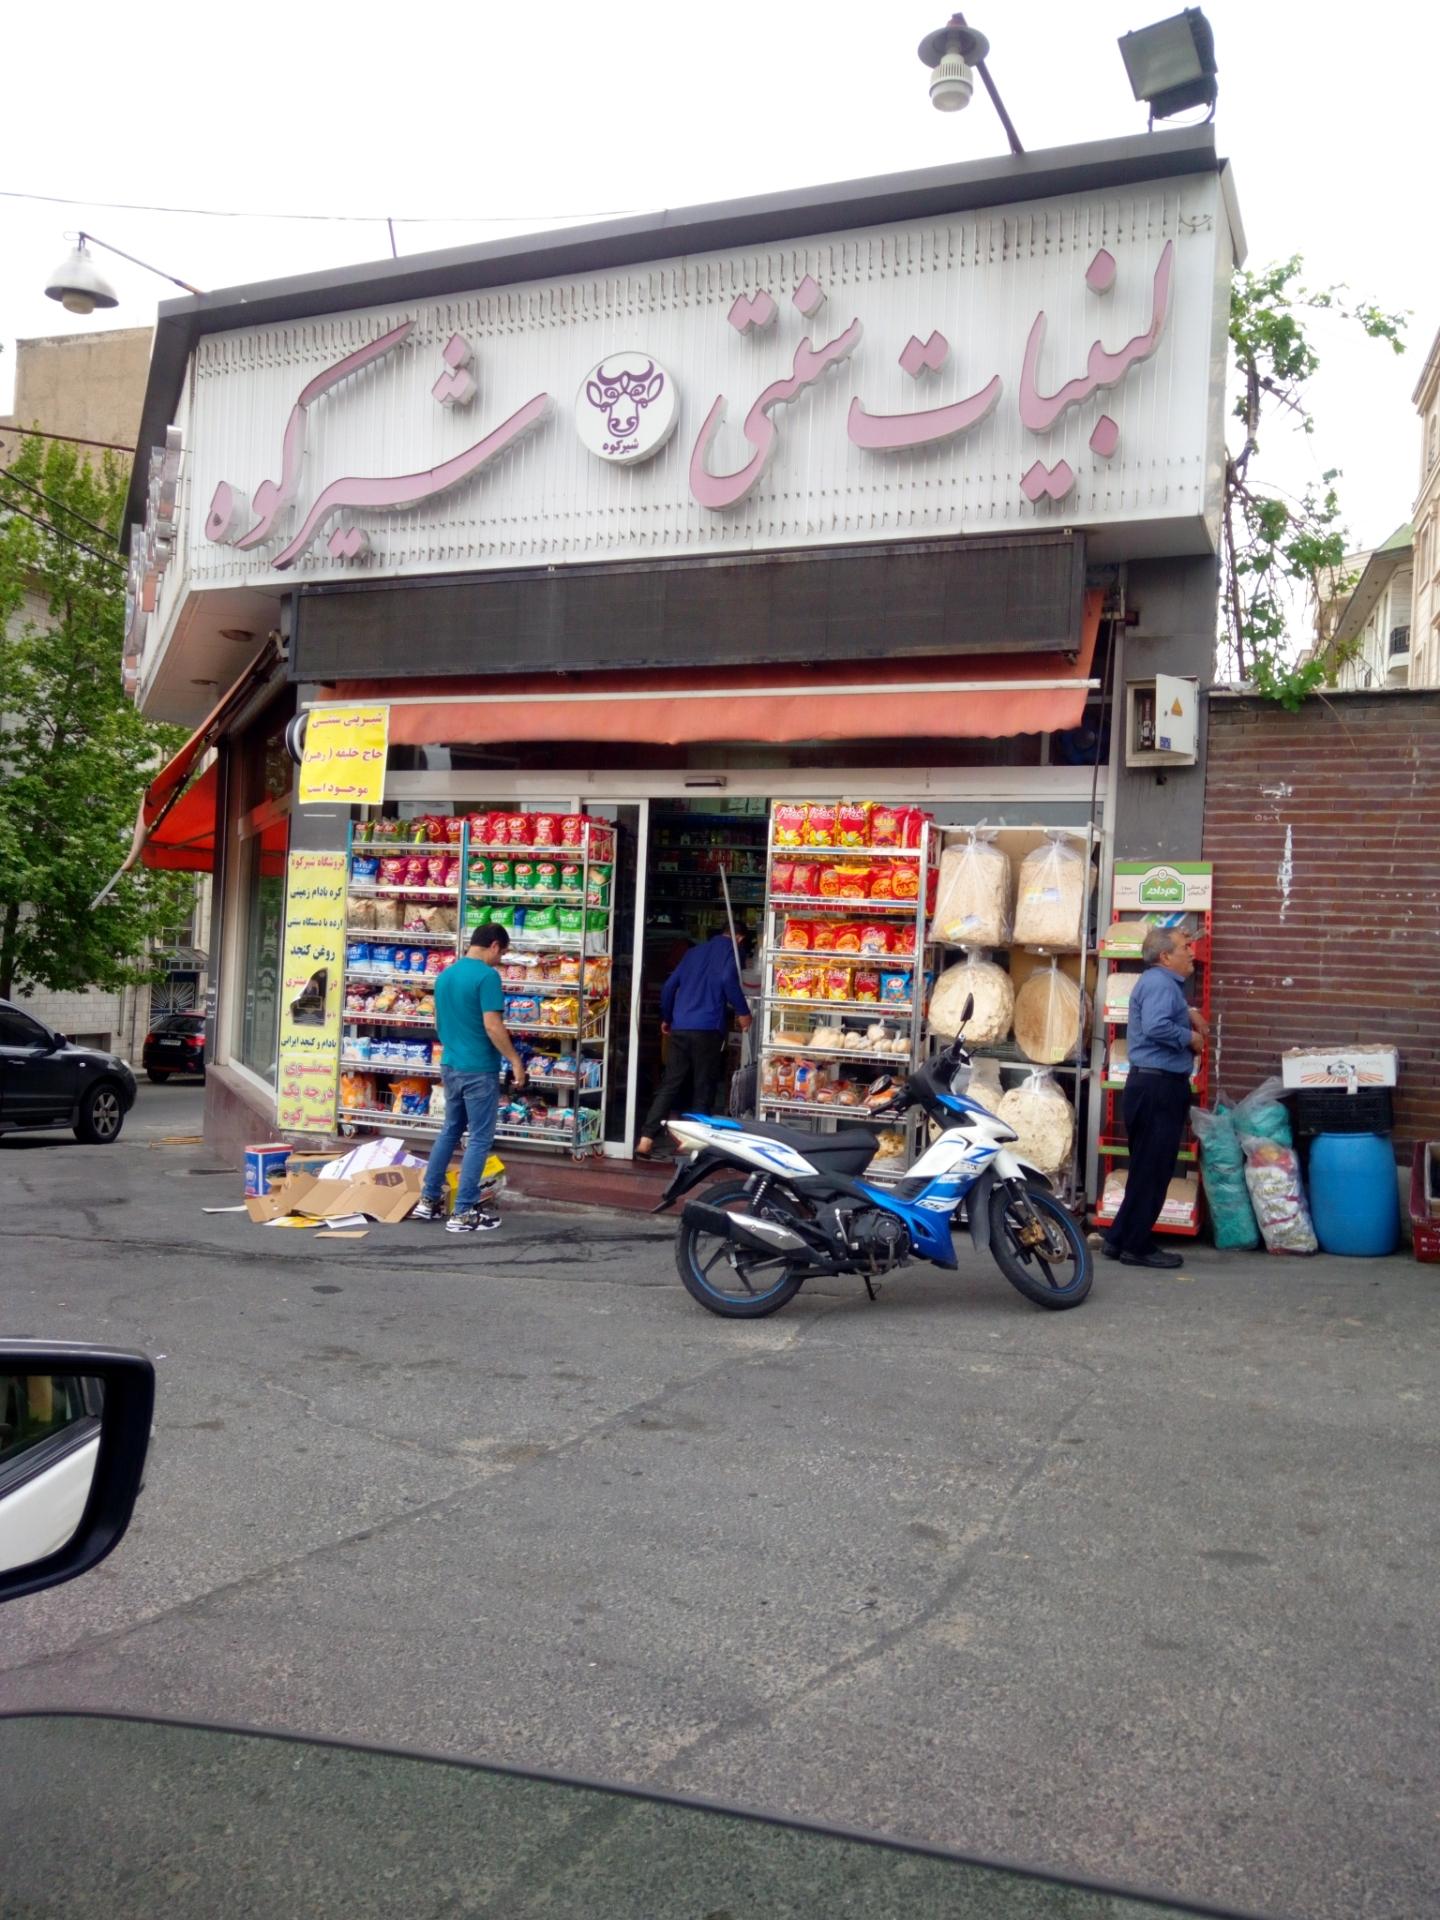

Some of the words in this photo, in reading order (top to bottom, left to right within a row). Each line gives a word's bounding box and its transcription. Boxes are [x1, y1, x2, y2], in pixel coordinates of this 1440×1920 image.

[846, 239, 1174, 505] لبنیات
[689, 274, 863, 512] سنتی
[204, 320, 552, 571] شیرکوه
[602, 439, 640, 455] شیرکوه
[335, 748, 359, 760] خلیفه
[362, 748, 383, 760] حاج
[328, 784, 368, 797] موجود
[290, 886, 310, 899] زمینی
[312, 886, 328, 899] بادام
[329, 886, 343, 900] کره
[290, 944, 312, 959] کنجد
[313, 946, 335, 961] روغن
[300, 1036, 316, 1047] کنجد
[321, 1036, 337, 1049] بادام
[303, 1086, 335, 1103] درجه
